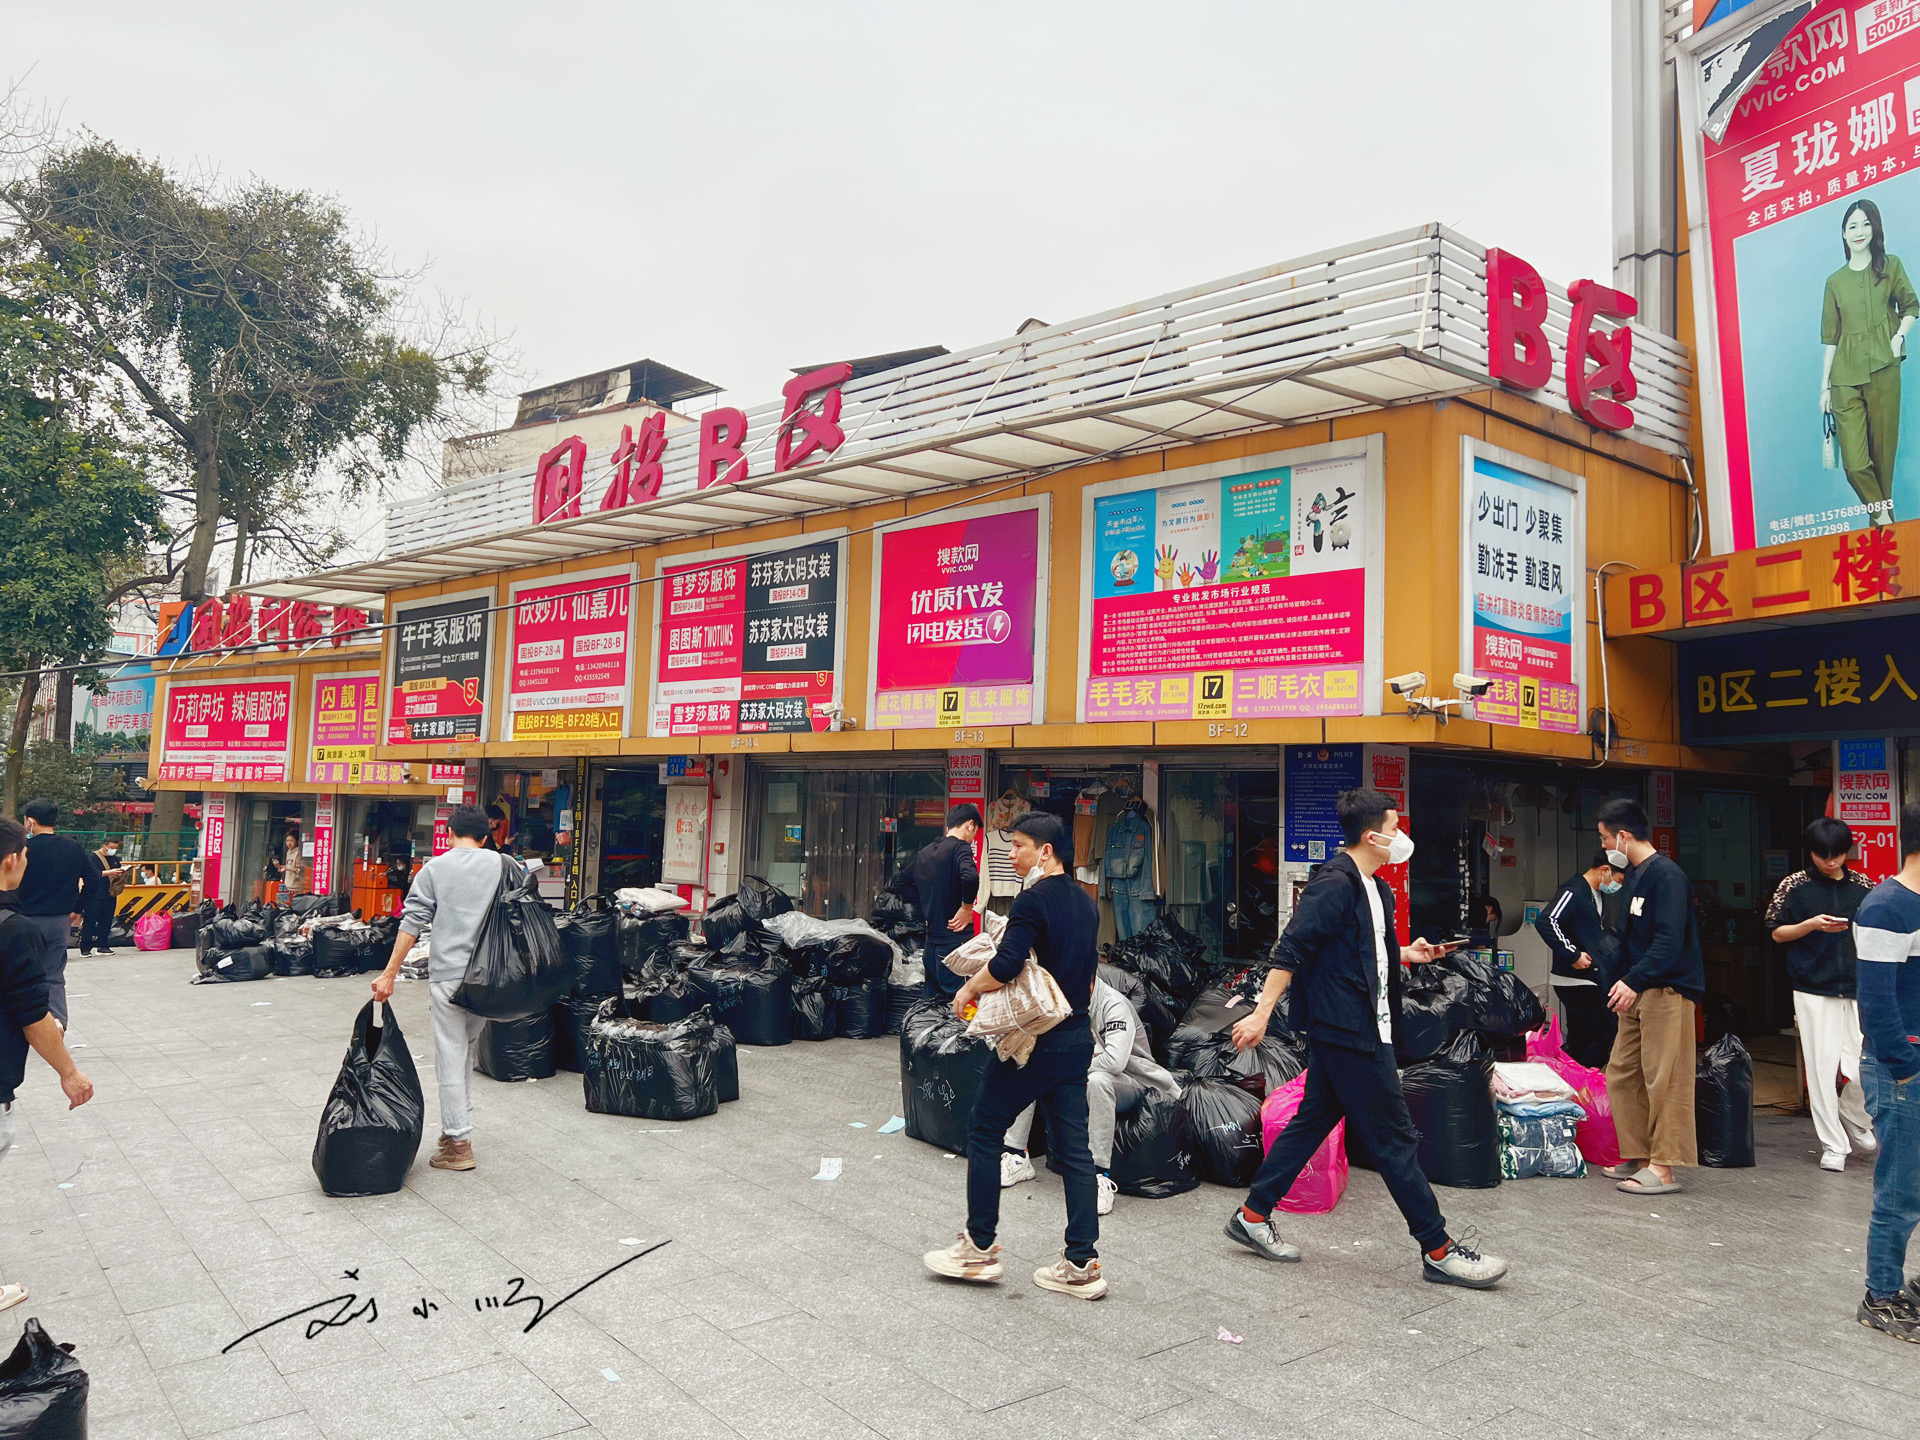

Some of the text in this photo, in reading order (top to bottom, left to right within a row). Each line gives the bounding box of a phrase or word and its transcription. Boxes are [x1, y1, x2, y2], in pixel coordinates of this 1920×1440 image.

[1743, 7, 1849, 95] 款网
[1738, 56, 1845, 118] VVIC.COM
[1740, 92, 1897, 204] 夏珑娜
[1487, 247, 1638, 431] B区
[1478, 491, 1563, 545] 少出门 少聚集
[1770, 521, 1851, 547] QQ:353272998
[936, 544, 979, 567] 搜款网
[751, 552, 831, 588] 芬芬家大码女装
[941, 564, 974, 574] VVIC.COM
[1477, 542, 1563, 595] 勤洗手 勤通风
[1629, 529, 1903, 629] B区二楼
[672, 567, 737, 597] 雪梦莎服饰
[1172, 583, 1271, 604] 专业批发市场行业规范
[518, 587, 628, 625] 欣妙儿 仙嘉儿
[910, 581, 1004, 615] 优质代发
[402, 613, 482, 652] 牛牛家服饰
[669, 625, 703, 652] 图图斯
[748, 612, 829, 644] 苏苏家大码女装
[906, 616, 984, 645] 闪电发货
[520, 636, 621, 660] 国投BF-28-A 国投BF-28-B
[1485, 633, 1523, 661] 搜款网
[1490, 658, 1518, 671] VVIC.COM
[91, 690, 143, 708] 提高环境意识
[321, 684, 356, 709] 闪靓
[968, 688, 1030, 708] 乱来服饰
[1089, 679, 1156, 707] 毛毛家
[1237, 674, 1321, 701] 三顺毛衣
[1540, 686, 1577, 711] 三顺毛衣
[173, 690, 287, 723] 万莉伊坊 辣媚服饰
[673, 704, 731, 723] 雪梦莎服饰
[740, 700, 803, 721] 苏苏家大码女装
[413, 720, 455, 737] 牛牛家服饰
[516, 712, 618, 730] 国投BF19档-BF28档入口
[1208, 724, 1248, 738] BF-12
[954, 731, 984, 743] BF-13
[950, 755, 982, 769] 搜款网
[1333, 751, 1354, 759] POLICE
[1847, 751, 1866, 767] 21
[159, 765, 195, 780] 万莉伊坊
[225, 765, 264, 780] 辣媚服饰
[669, 763, 680, 775] 34
[1840, 773, 1890, 791] 搜款网
[1840, 793, 1888, 801] VVIC.COM
[213, 821, 223, 854] B区
